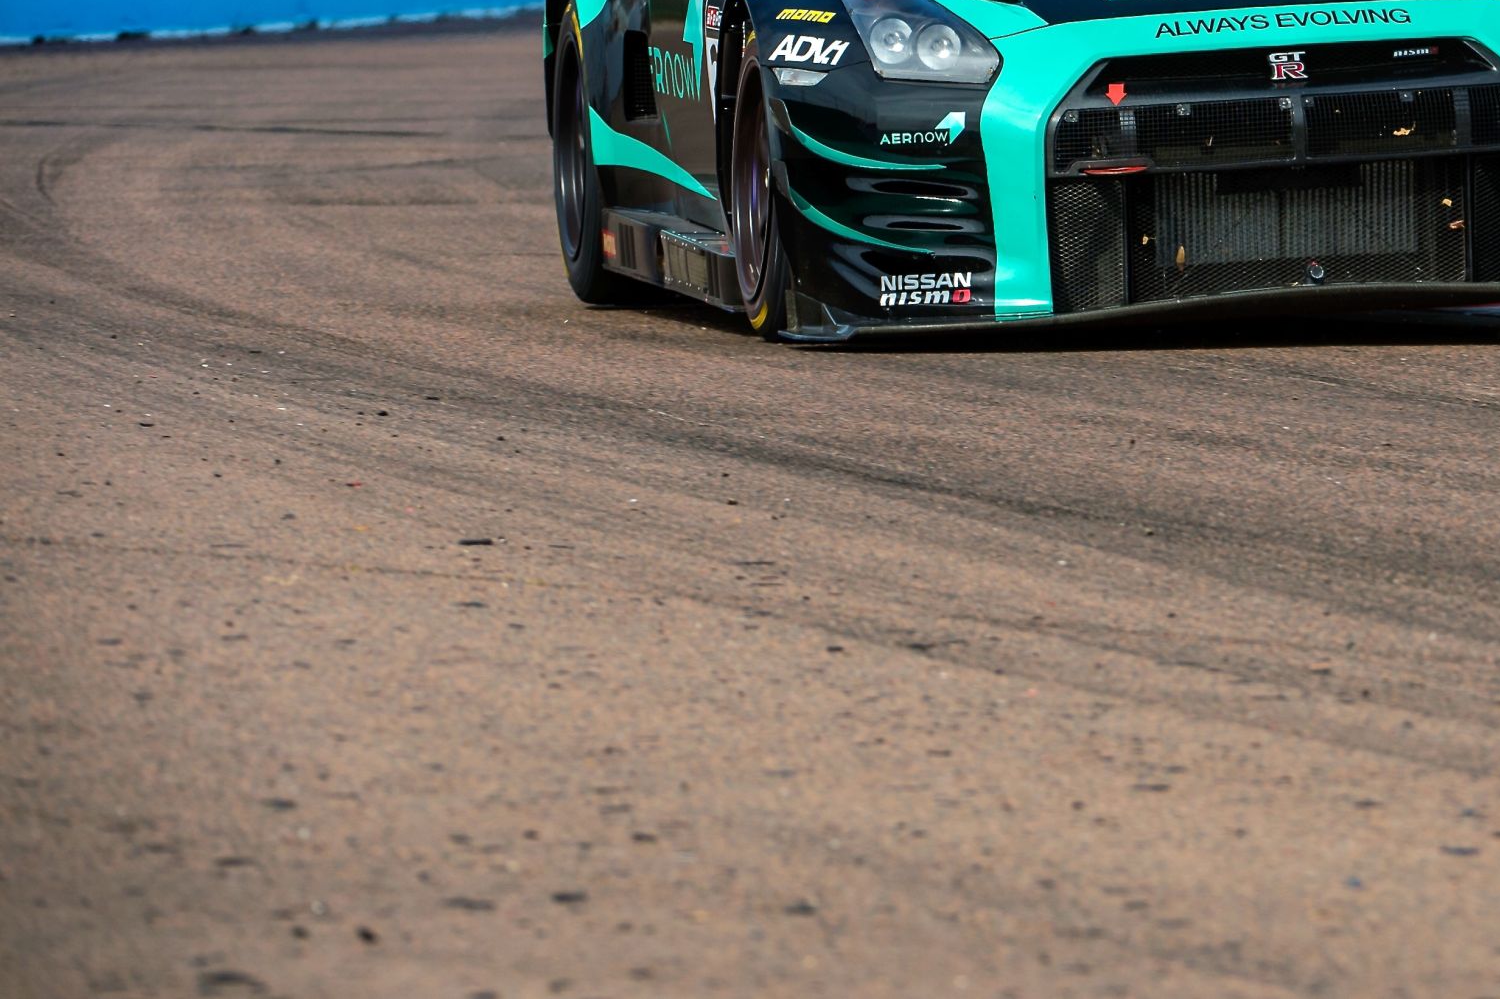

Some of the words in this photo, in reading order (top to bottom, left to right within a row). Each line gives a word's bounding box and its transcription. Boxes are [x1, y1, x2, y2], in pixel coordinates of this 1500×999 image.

[1155, 14, 1270, 39] ALWAYS
[1276, 8, 1412, 29] EVOLVING
[1269, 51, 1306, 63] GT
[1271, 62, 1309, 80] R
[880, 271, 972, 293] NISSAN
[880, 288, 973, 308] nismo
